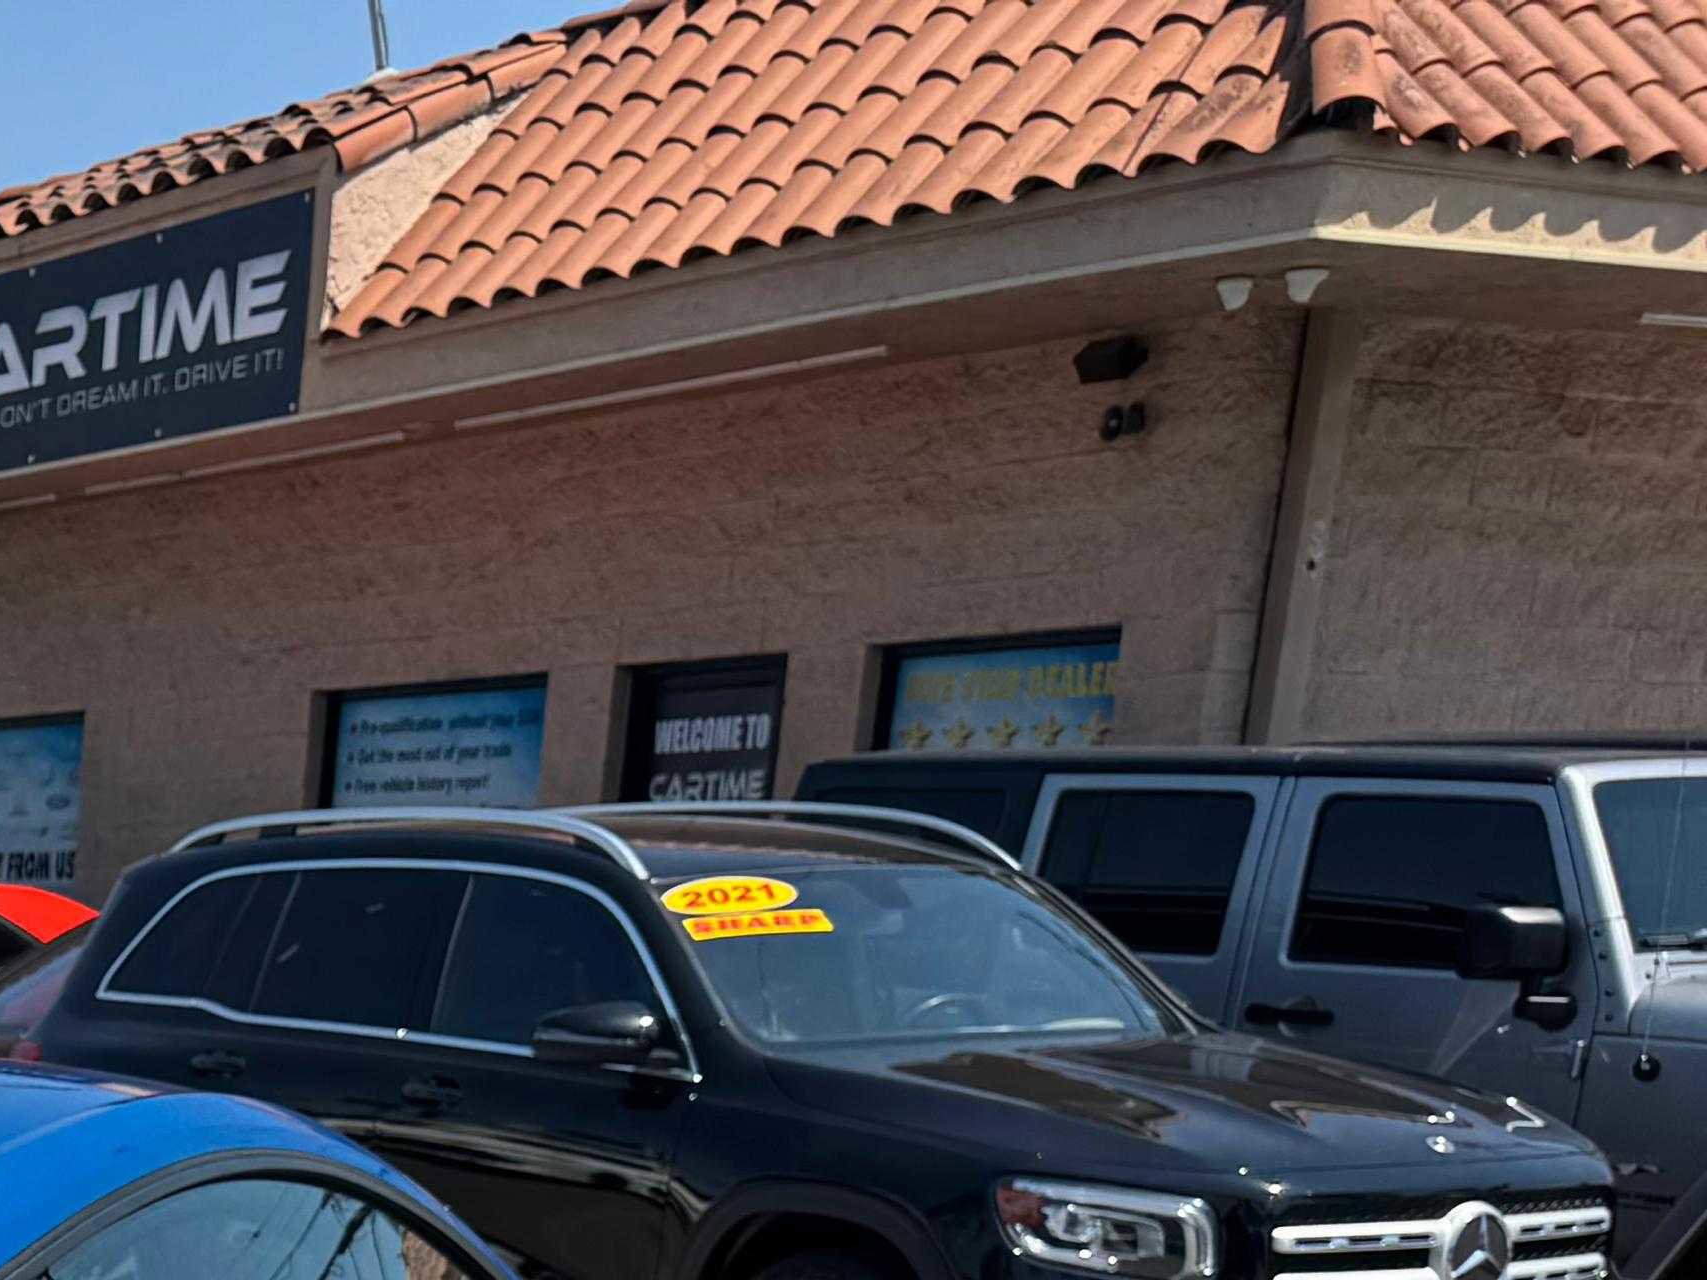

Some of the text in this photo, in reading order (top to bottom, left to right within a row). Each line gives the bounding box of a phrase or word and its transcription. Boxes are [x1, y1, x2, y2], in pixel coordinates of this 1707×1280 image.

[55, 377, 141, 417] DREAM
[174, 352, 249, 391] DRIVE
[252, 346, 286, 377] IT!
[655, 713, 772, 754] WELCOME TO
[649, 769, 766, 801] CARTIME
[5, 851, 50, 880] FROM
[55, 850, 76, 879] US
[683, 884, 776, 908] 2021
[694, 914, 819, 934] SHARP
